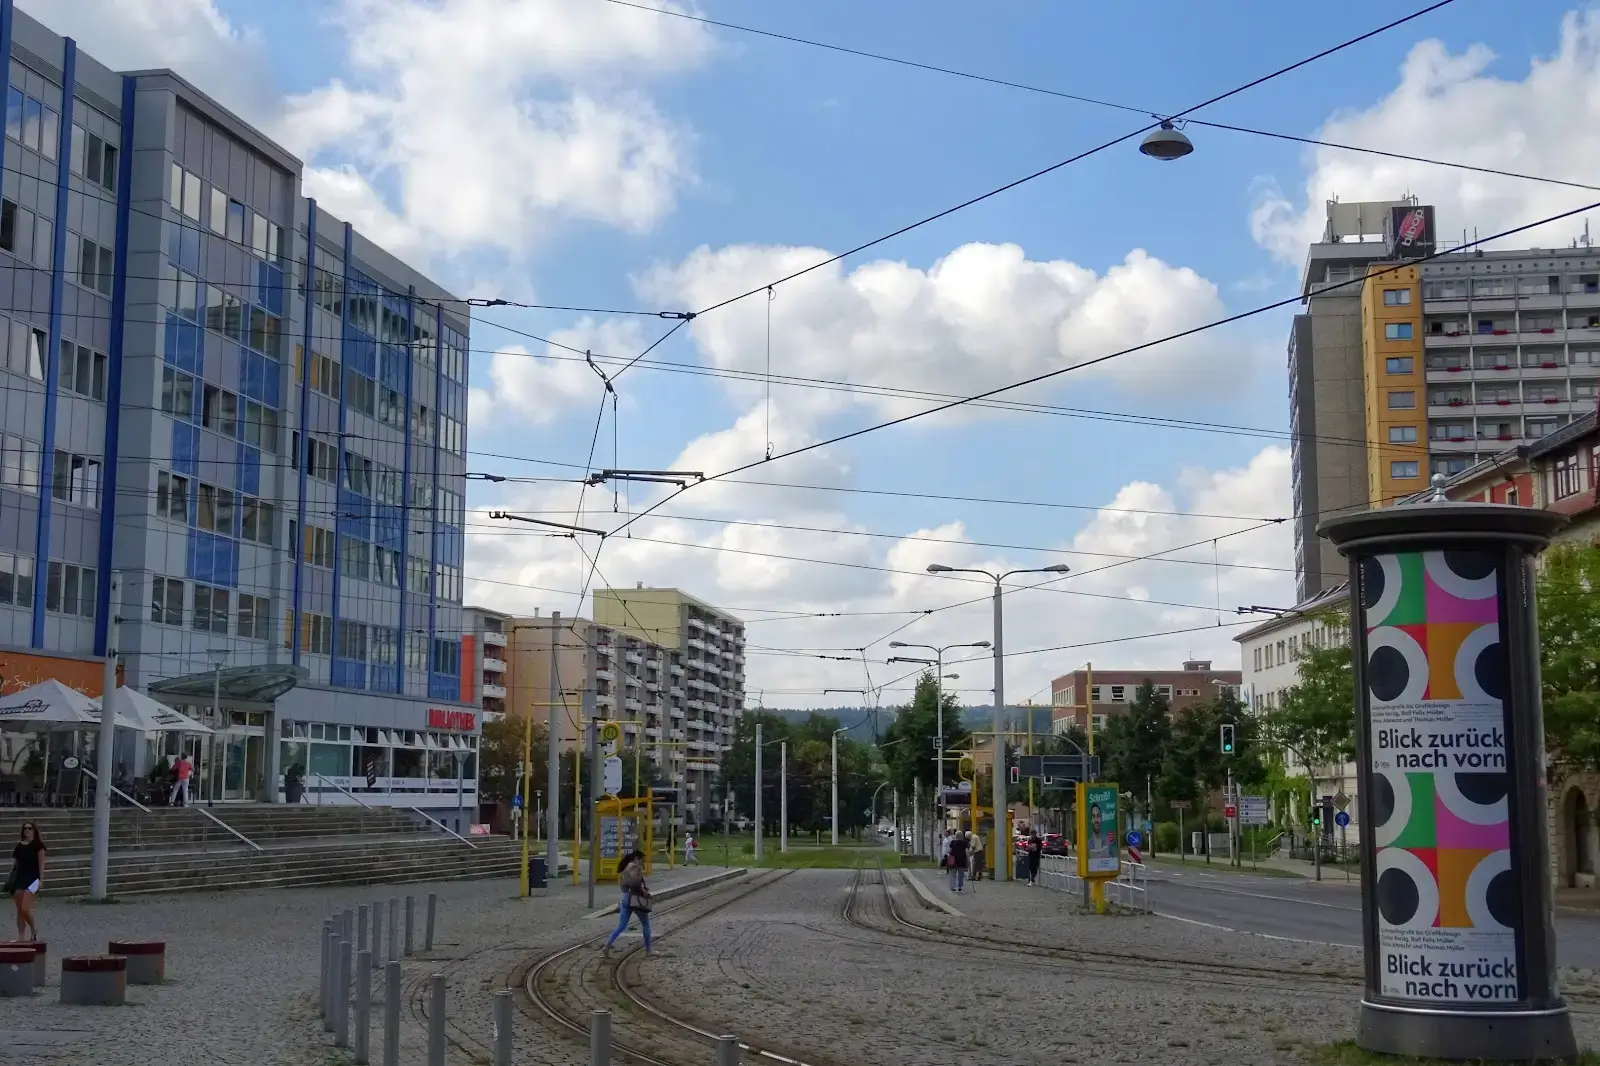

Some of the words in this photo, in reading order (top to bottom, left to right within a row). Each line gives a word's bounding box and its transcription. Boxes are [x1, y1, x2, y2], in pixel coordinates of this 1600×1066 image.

[1378, 727, 1423, 749] Blick
[1428, 727, 1504, 748] zurück
[1396, 749, 1448, 768] nach
[1453, 753, 1506, 768] vorn
[1387, 953, 1433, 976] Blick
[1438, 956, 1516, 978] zurück
[1405, 979, 1458, 998] nach
[1464, 983, 1517, 999] vorn
